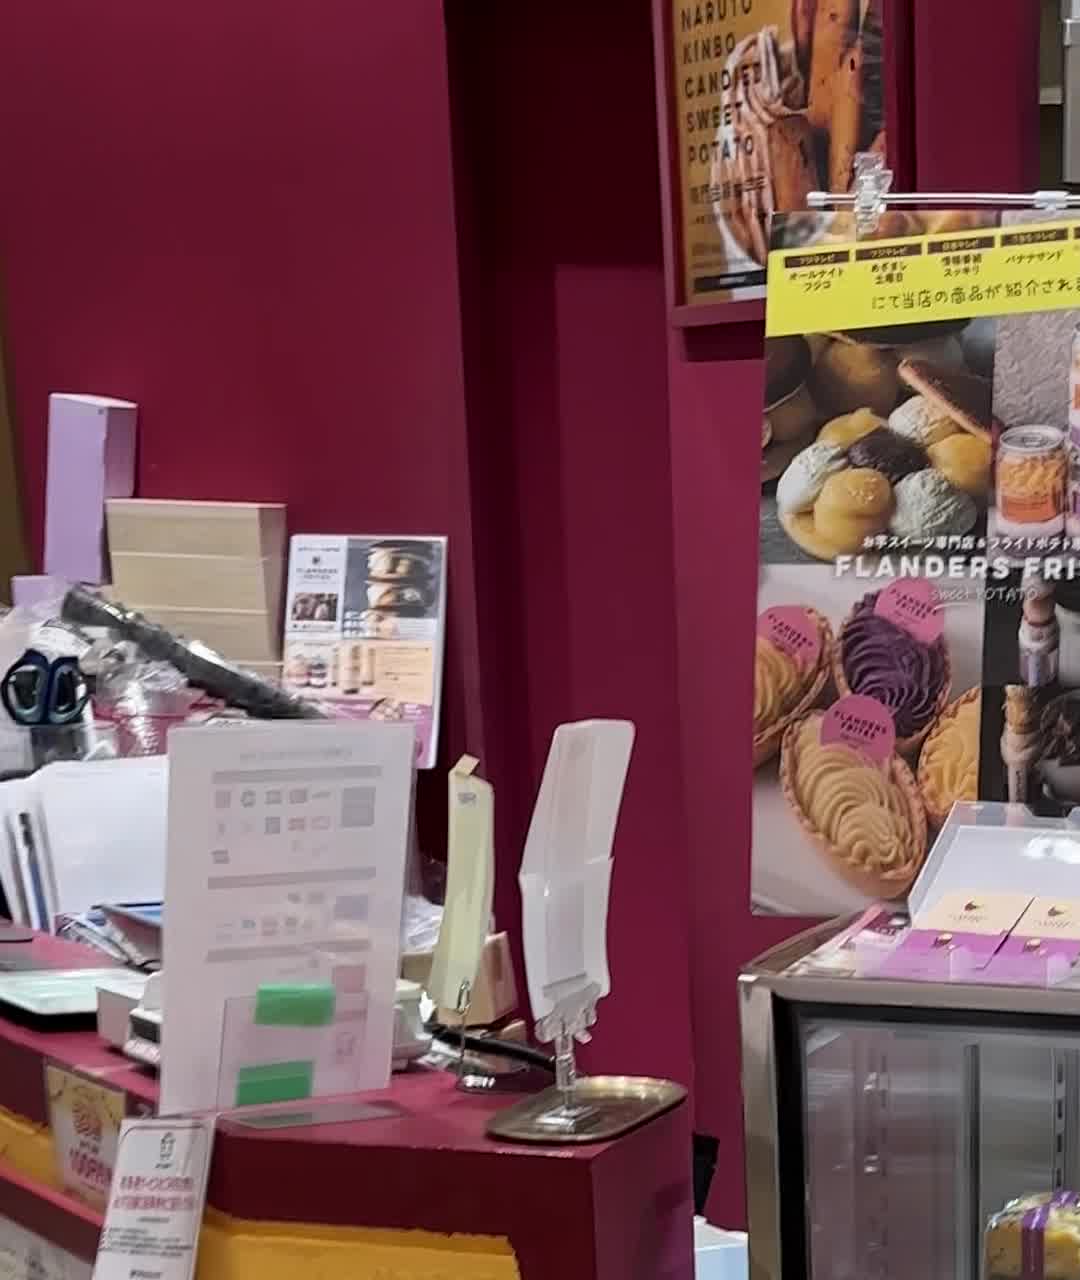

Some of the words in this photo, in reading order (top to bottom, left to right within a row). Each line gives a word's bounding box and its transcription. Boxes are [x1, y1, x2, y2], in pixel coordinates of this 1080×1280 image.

[686, 101, 744, 132] SWEET
[688, 135, 754, 164] POTATO
[834, 554, 1011, 580] FLANDERS
